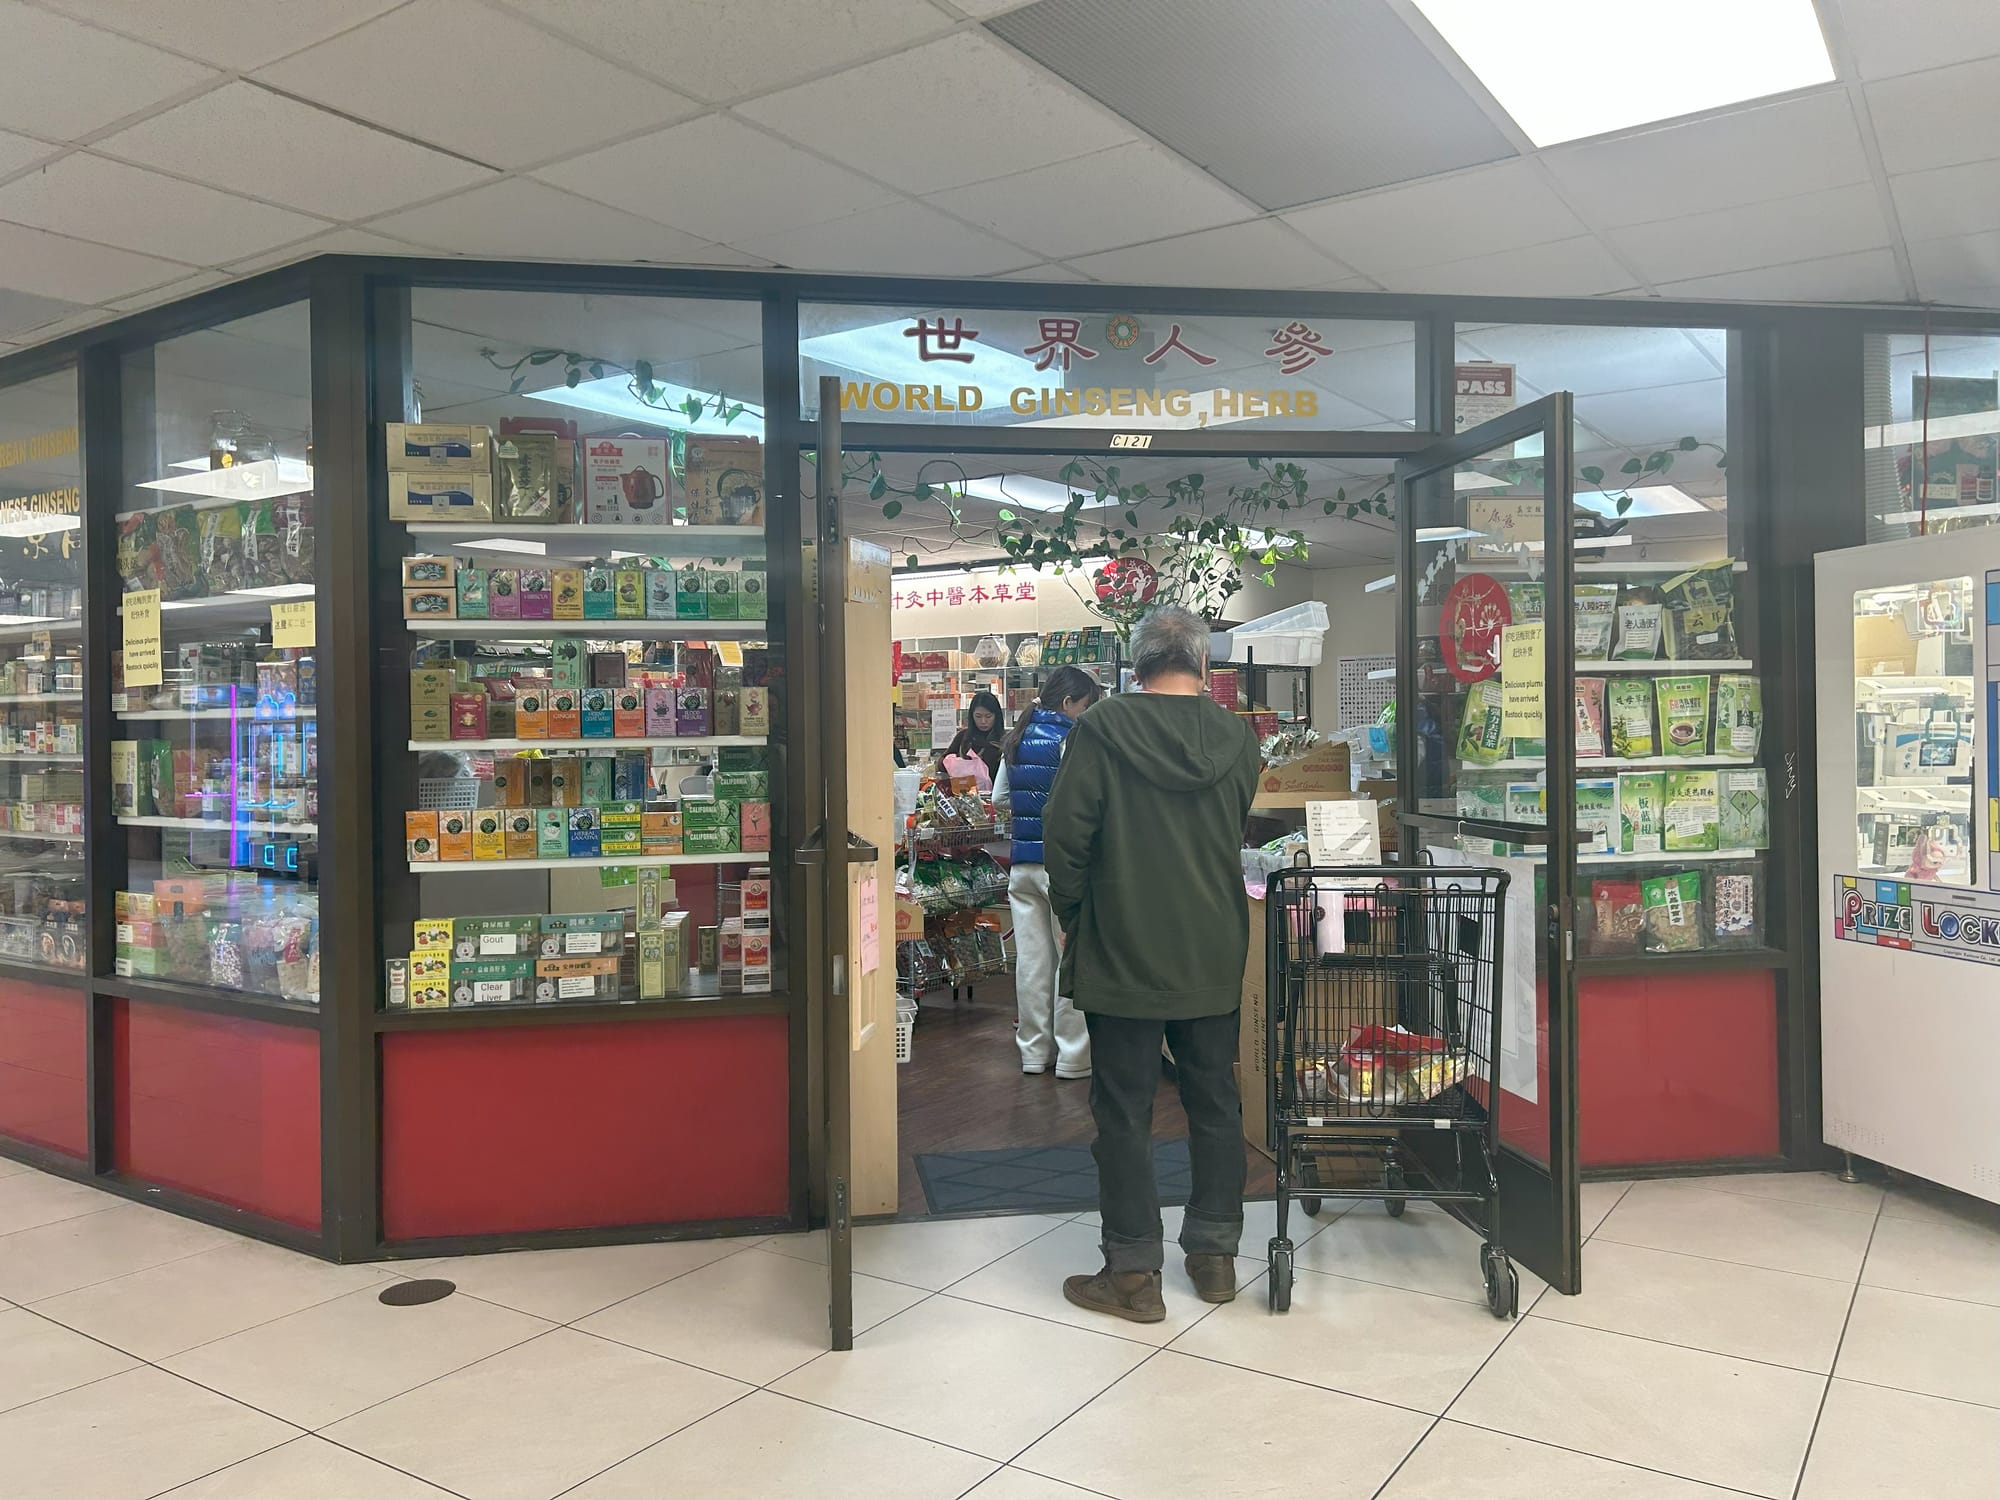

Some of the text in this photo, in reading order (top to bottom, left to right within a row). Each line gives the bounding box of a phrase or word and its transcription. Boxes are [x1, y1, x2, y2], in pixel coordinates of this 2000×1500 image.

[1456, 380, 1506, 394] PASS
[839, 382, 984, 412] WORLD
[30, 487, 80, 520] GINSENG
[1505, 680, 1526, 689] Delicious
[1520, 694, 1539, 702] arrived
[1505, 711, 1523, 719] Restock
[482, 935, 504, 944] Gout
[480, 983, 504, 991] Clear
[481, 993, 503, 1001] Liver
